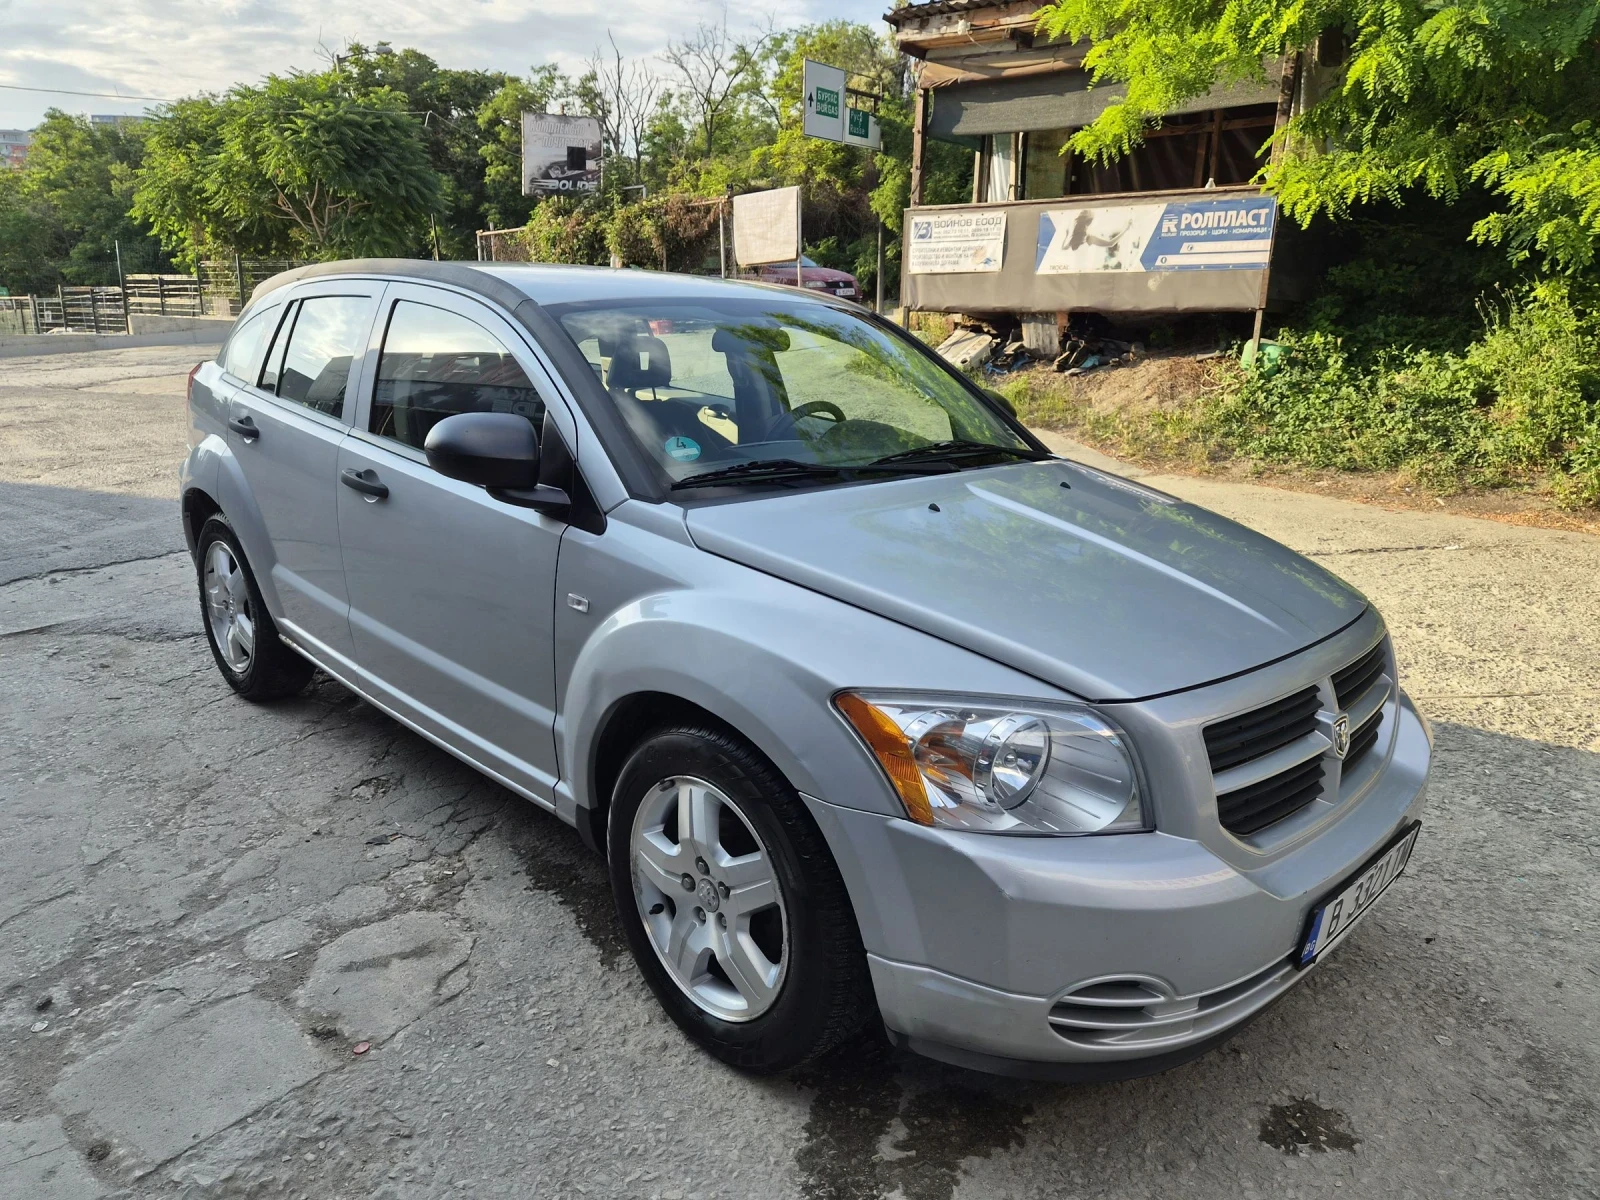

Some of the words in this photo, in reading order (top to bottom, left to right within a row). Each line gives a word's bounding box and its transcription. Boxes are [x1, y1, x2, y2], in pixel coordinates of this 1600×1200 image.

[817, 90, 838, 104] БУРГАС
[816, 103, 838, 115] BURGAS
[530, 121, 586, 135] КОМПЛЕКСНО
[542, 136, 593, 151] ПОЧИСТВАНЕ
[934, 218, 973, 229] ВОЙНОВ
[975, 216, 1002, 227] ЕООД
[1180, 208, 1270, 229] РОЛПЛАСТ
[676, 437, 687, 449] 4
[1327, 898, 1344, 940] B
[1346, 853, 1392, 919] 3321
[1304, 939, 1316, 956] BG
